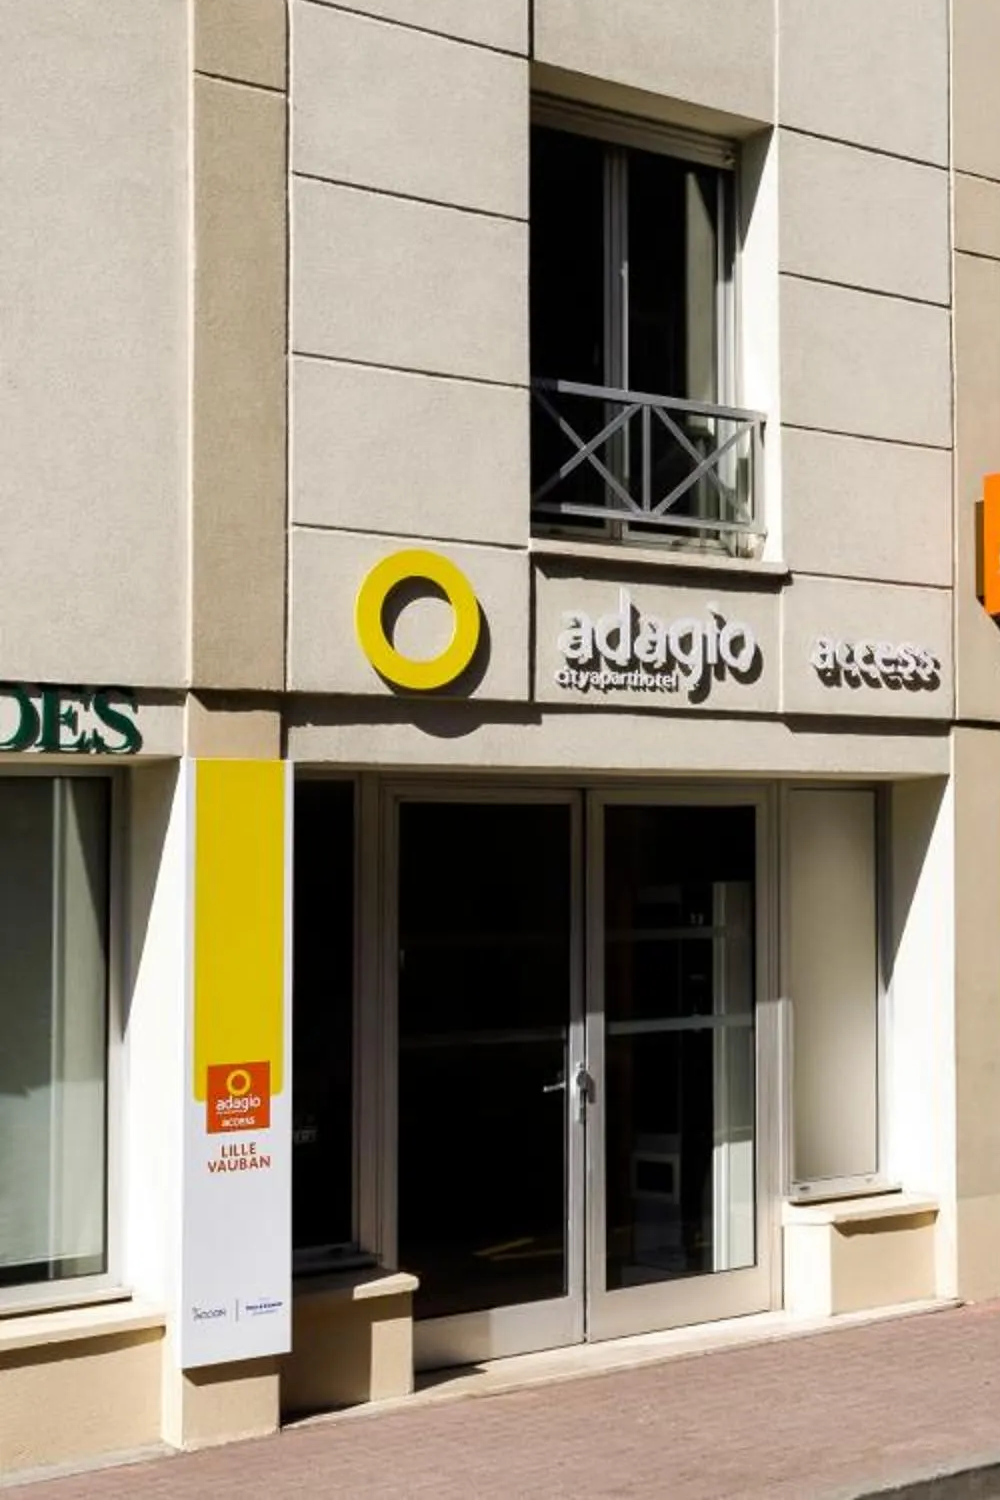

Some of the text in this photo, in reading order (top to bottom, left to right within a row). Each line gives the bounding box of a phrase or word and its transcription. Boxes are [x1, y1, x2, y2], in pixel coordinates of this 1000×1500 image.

[558, 587, 755, 691] adagio
[812, 639, 937, 681] access
[216, 1094, 260, 1112] adagio
[221, 1142, 257, 1158] LILLE
[207, 1156, 271, 1173] VAUBAN
